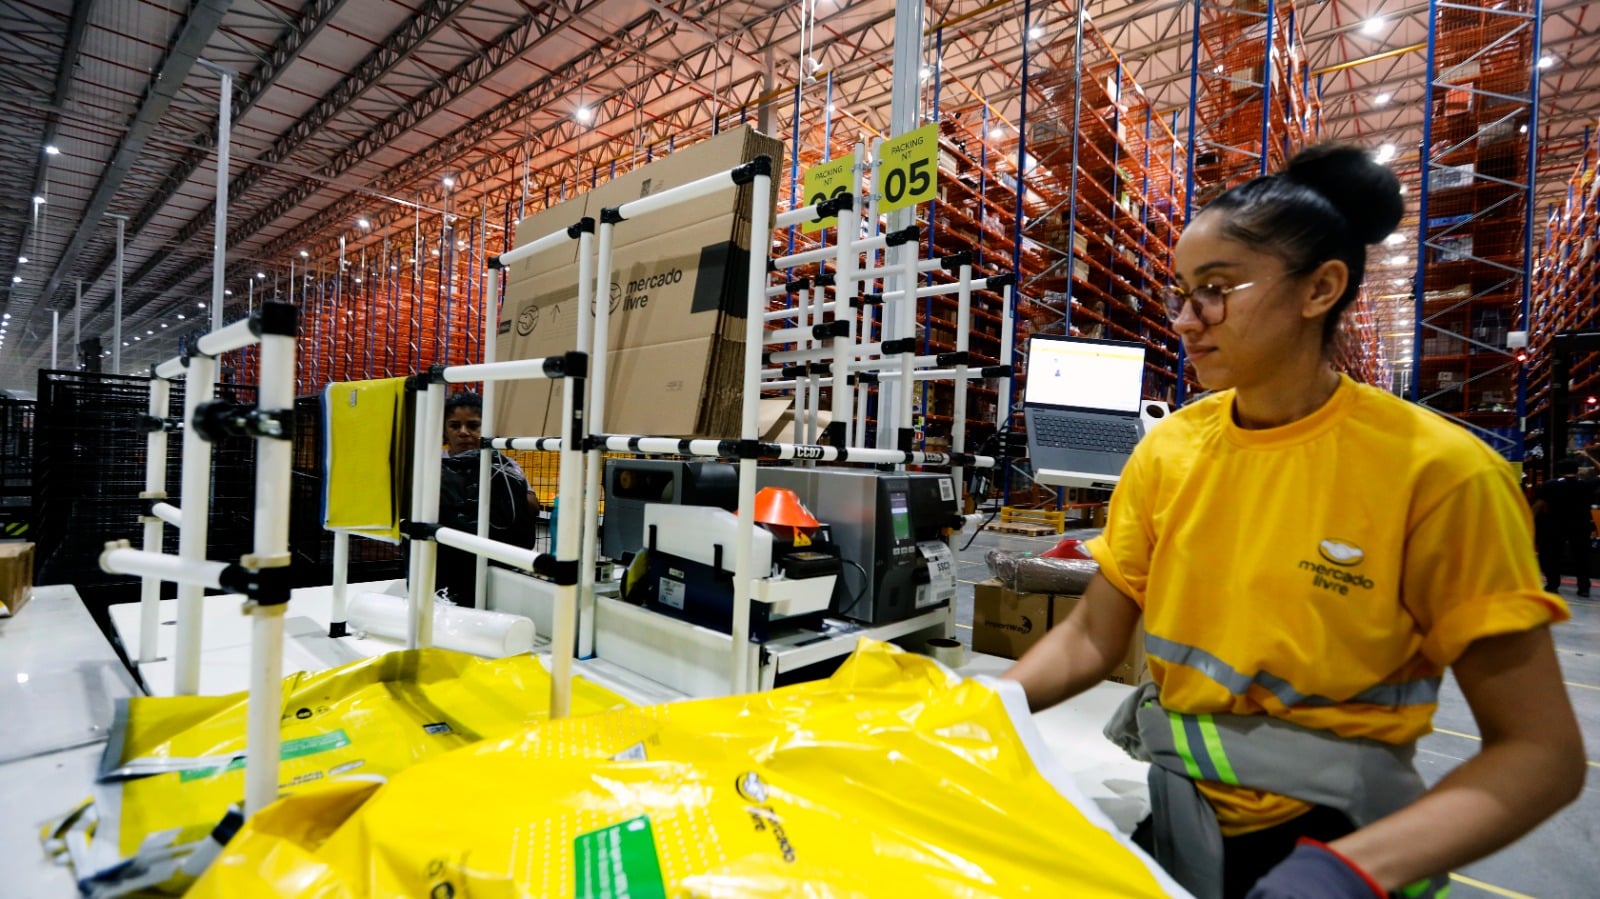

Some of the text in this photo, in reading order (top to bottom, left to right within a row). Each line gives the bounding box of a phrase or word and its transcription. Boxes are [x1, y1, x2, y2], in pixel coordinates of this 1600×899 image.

[892, 137, 924, 153] PACKING
[902, 150, 912, 161] NT
[814, 165, 843, 181] PACKING
[823, 177, 833, 186] NT
[885, 158, 930, 203] 05
[626, 268, 682, 292] mercado
[622, 293, 649, 312] livre
[797, 448, 821, 458] CC07
[1298, 559, 1375, 590] mercado
[1312, 574, 1349, 596] livre
